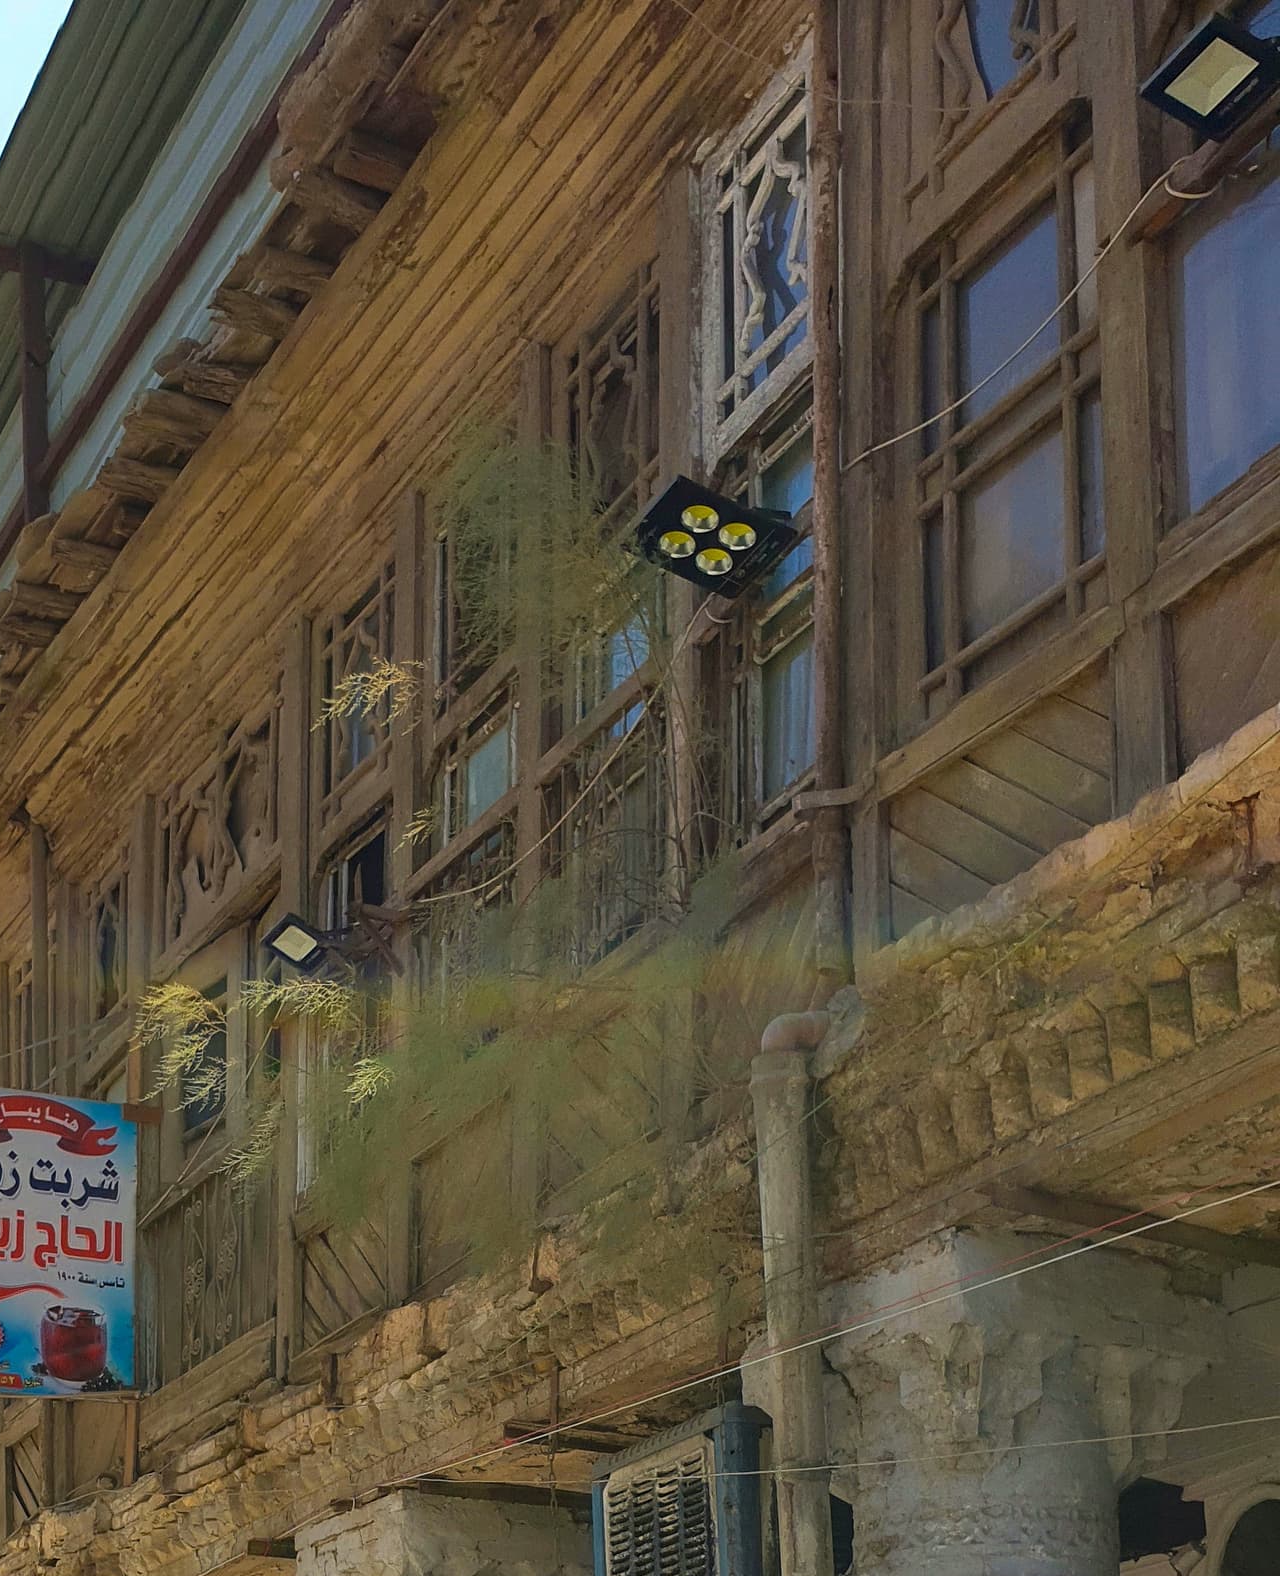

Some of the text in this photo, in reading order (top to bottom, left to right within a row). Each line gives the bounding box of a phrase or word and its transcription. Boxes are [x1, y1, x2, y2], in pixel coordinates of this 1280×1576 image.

[45, 1106, 79, 1131] هنا
[29, 1159, 120, 1209] شربت
[33, 1214, 124, 1269] الحاج
